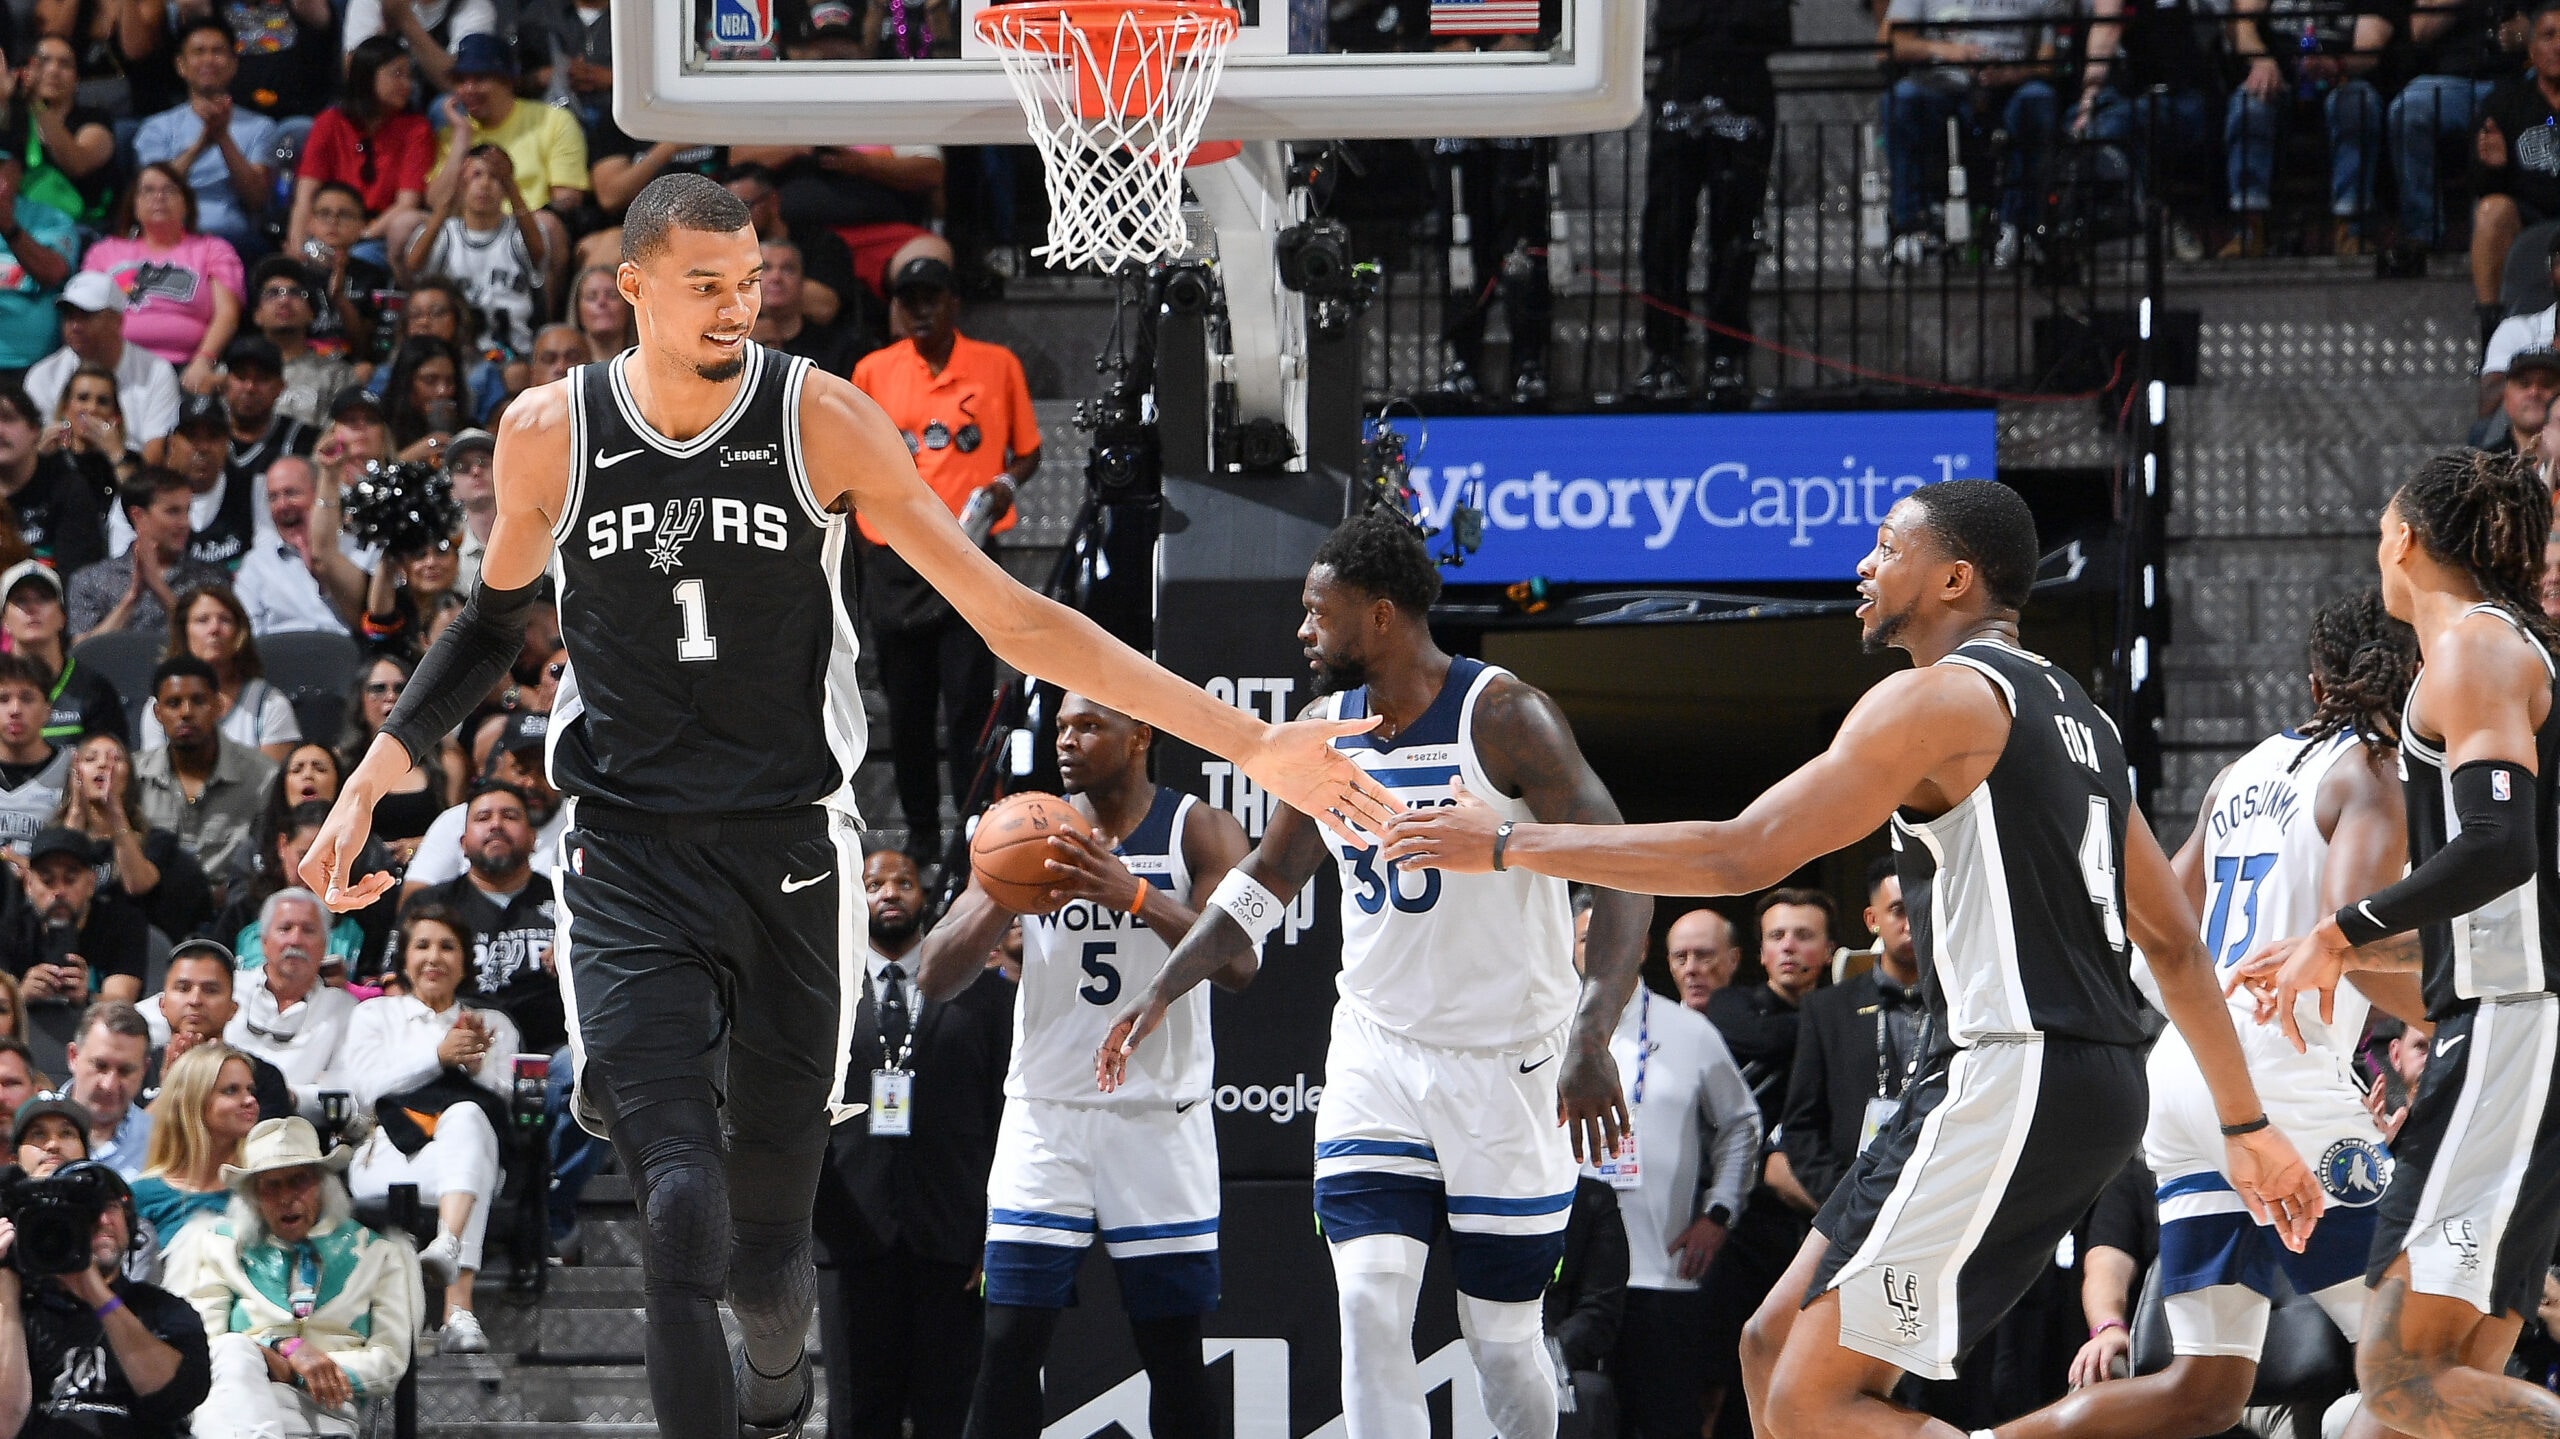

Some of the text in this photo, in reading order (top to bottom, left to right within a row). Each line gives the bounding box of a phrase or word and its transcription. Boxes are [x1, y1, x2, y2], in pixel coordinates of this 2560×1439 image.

[721, 13, 749, 36] NBA
[727, 450, 770, 462] LEDGER
[587, 497, 788, 574] SPURS
[672, 578, 718, 662] 1
[1414, 751, 1448, 761] sezzle
[2053, 714, 2102, 774] FOX
[1201, 761, 1280, 837] TH
[1341, 844, 1441, 913] 30
[2078, 795, 2127, 952] 4
[1038, 904, 1151, 931] WOLVE
[1238, 892, 1264, 918] 30
[2206, 852, 2279, 968] 13
[1080, 941, 1121, 1006] 5
[1209, 1073, 1324, 1124] oogle
